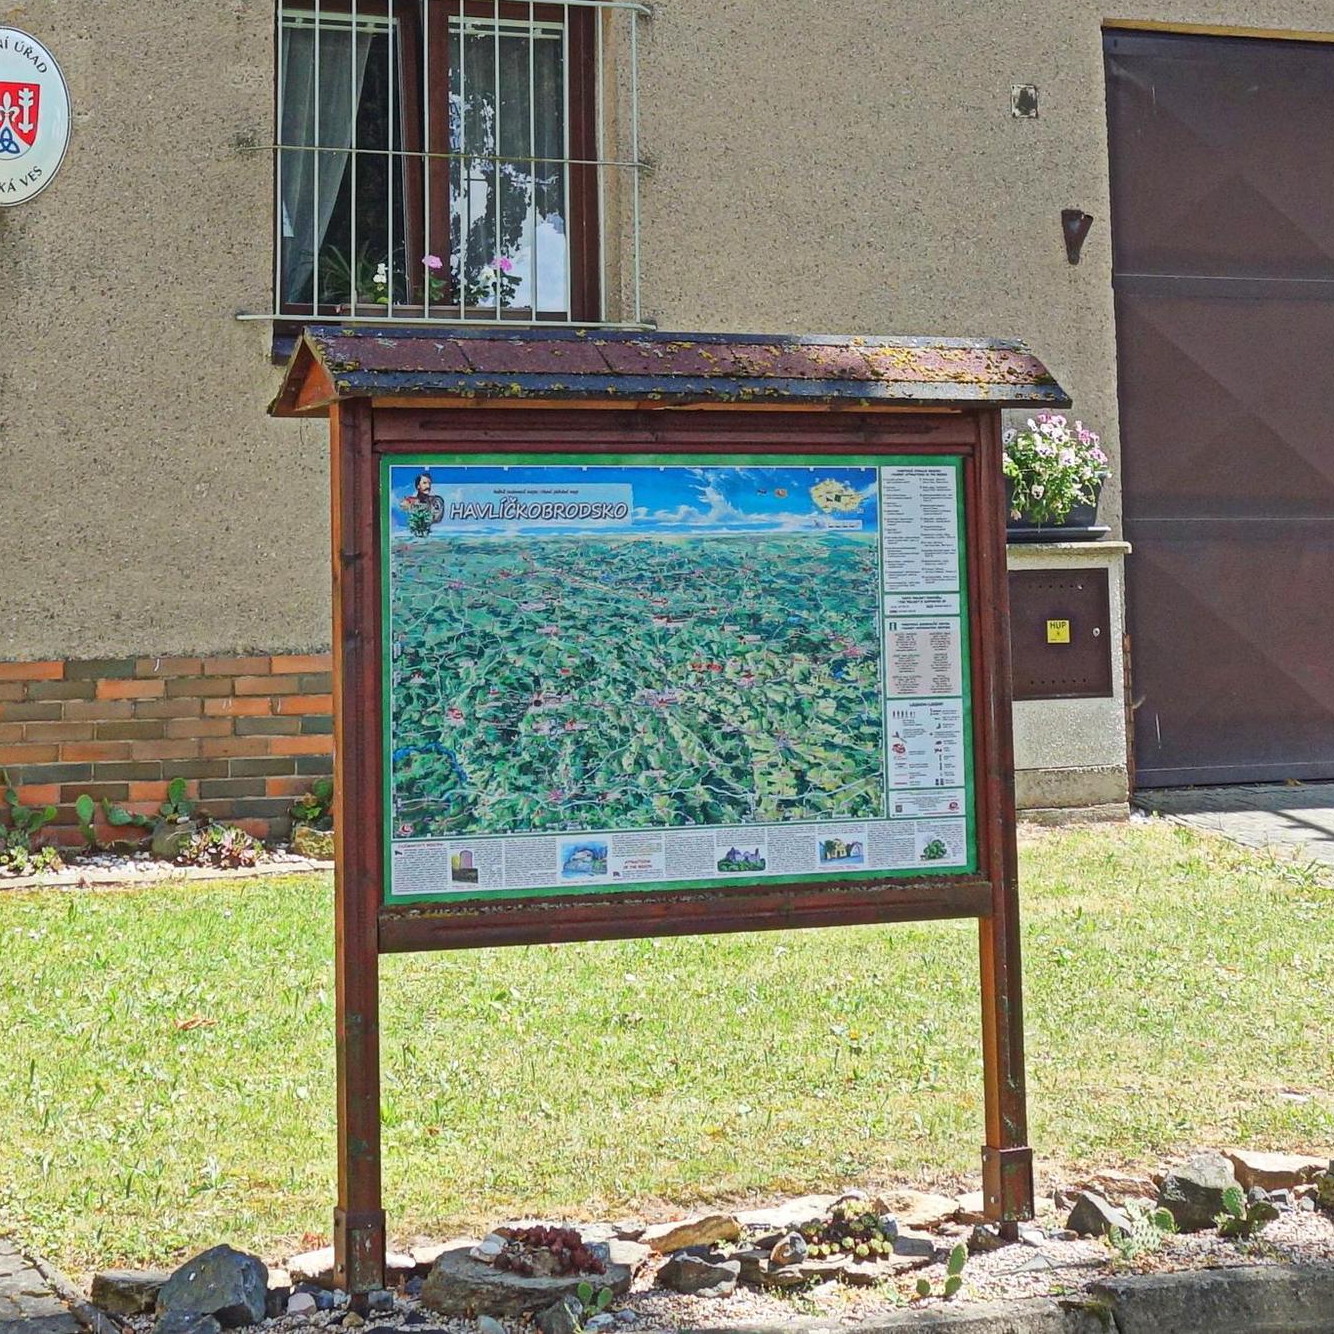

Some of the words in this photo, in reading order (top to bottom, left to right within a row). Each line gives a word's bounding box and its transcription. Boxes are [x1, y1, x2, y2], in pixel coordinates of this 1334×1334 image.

[13, 40, 48, 74] ÚŘAD
[19, 165, 43, 187] VES
[450, 495, 629, 521] HAVLÍČKOBRODSKO
[1049, 621, 1067, 630] HUP
